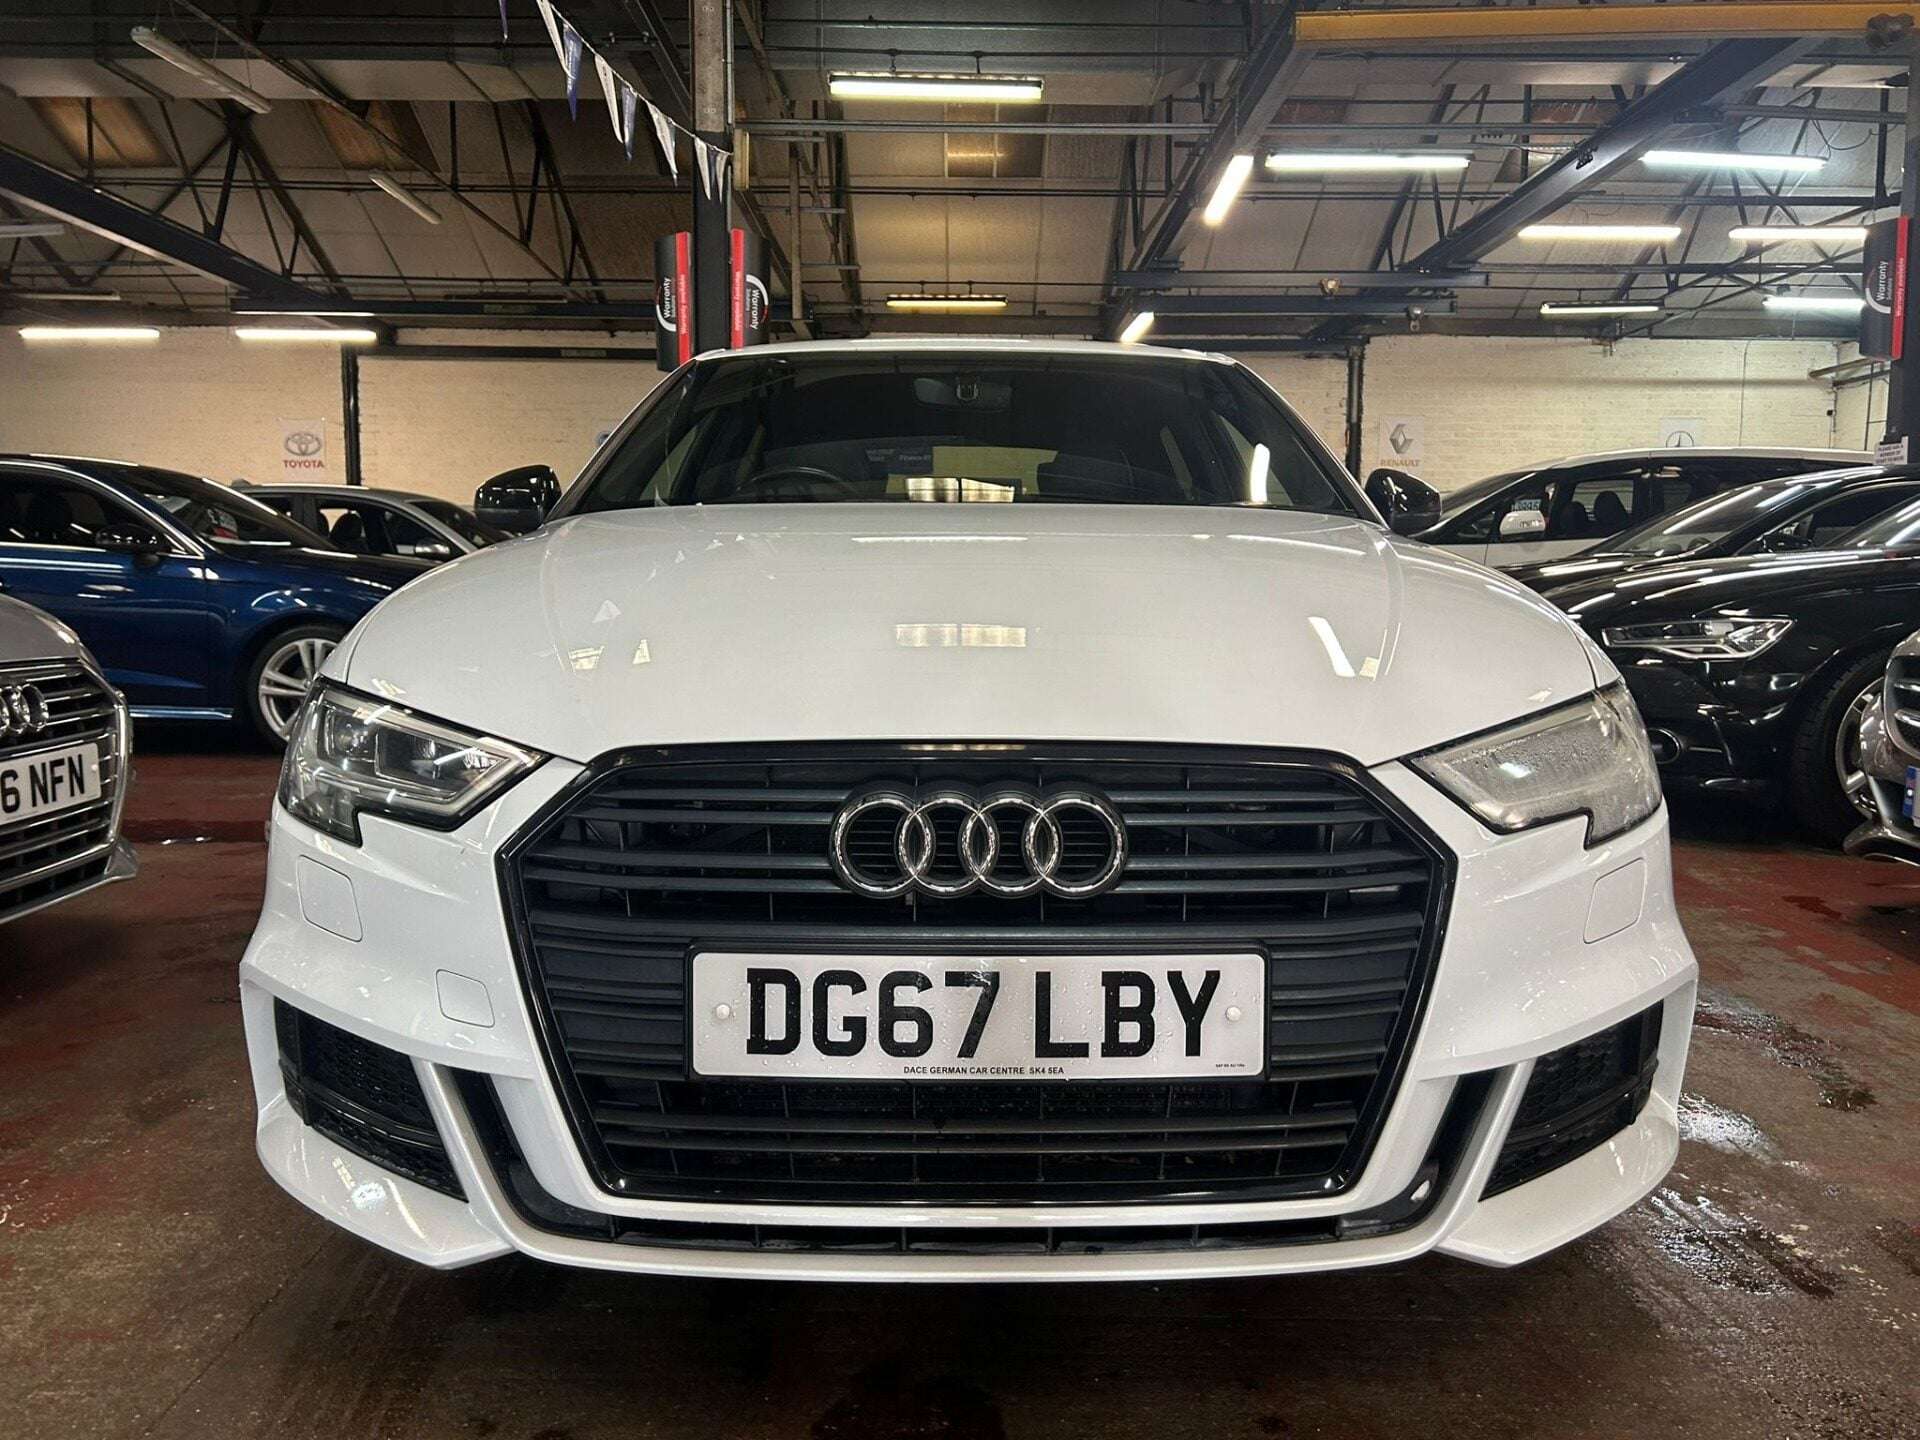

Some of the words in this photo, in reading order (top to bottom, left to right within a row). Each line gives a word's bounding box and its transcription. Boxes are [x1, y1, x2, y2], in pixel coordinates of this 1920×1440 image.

[662, 277, 672, 318] Warranty
[1876, 260, 1889, 301] Warranty
[750, 289, 760, 330] Warranty
[283, 460, 324, 468] TOYOTA
[0, 769, 20, 814] 6
[29, 754, 85, 807] NFN
[746, 968, 1000, 1058] DG67
[1034, 969, 1221, 1058] LBY
[903, 1066, 928, 1075] DACE
[929, 1066, 968, 1075] GERMAN
[969, 1066, 989, 1075] CAR
[989, 1066, 1025, 1075] CENTRE
[1029, 1066, 1046, 1075] SK4
[1047, 1066, 1065, 1075] 5EA
